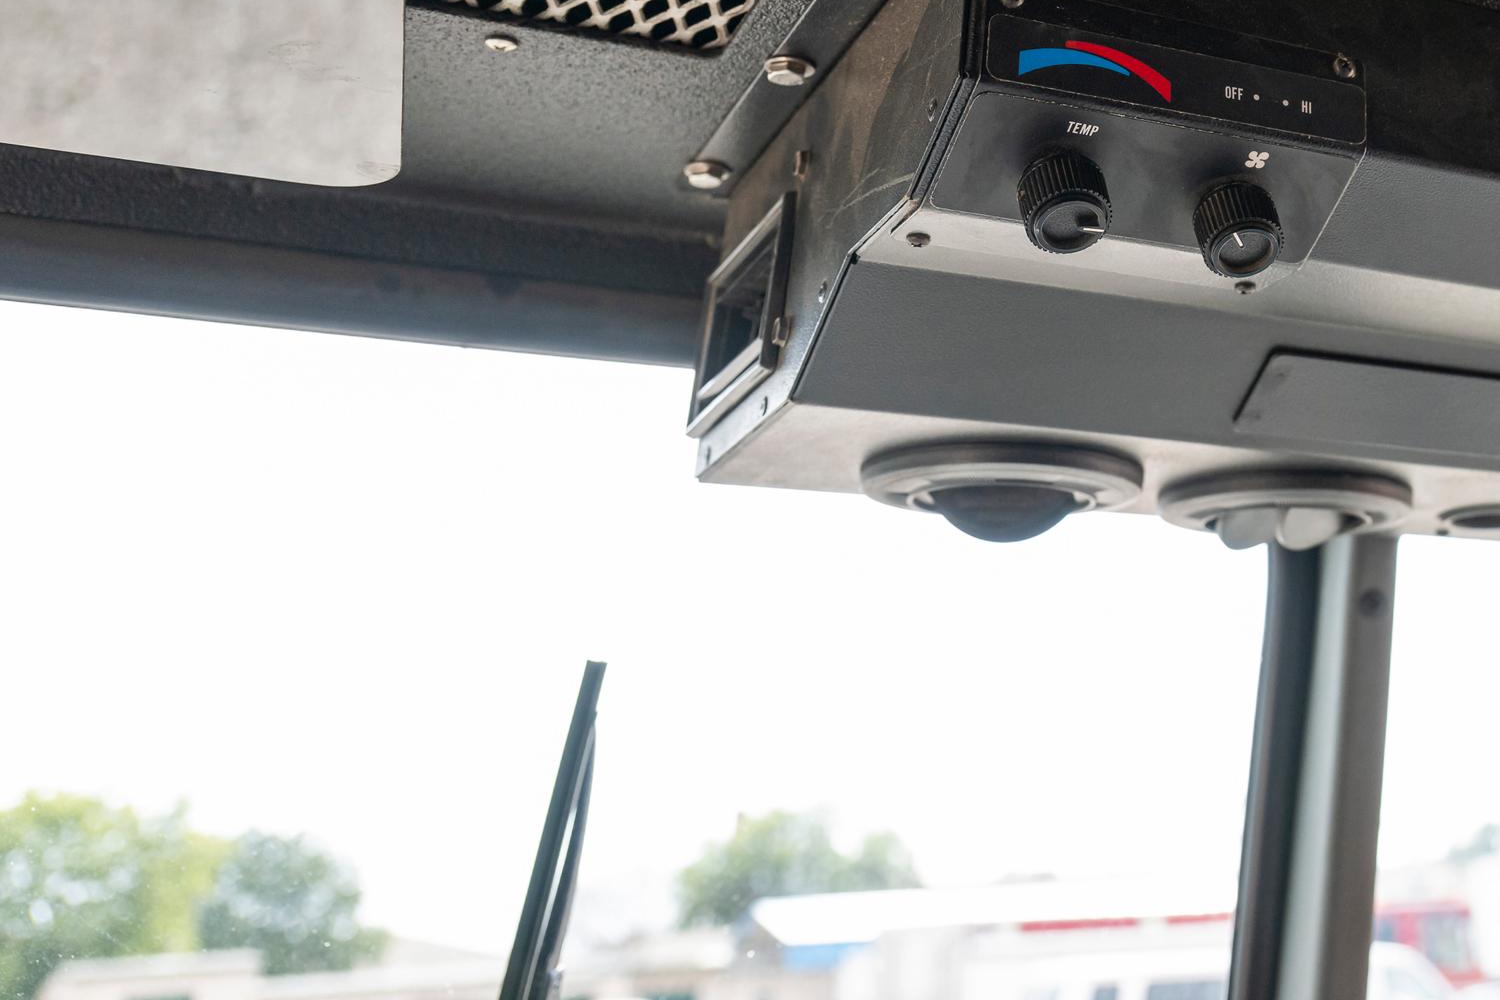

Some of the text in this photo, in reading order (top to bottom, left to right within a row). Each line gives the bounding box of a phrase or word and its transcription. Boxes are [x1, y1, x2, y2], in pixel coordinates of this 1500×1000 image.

[1224, 86, 1312, 114] OFF HI
[1066, 121, 1100, 138] TEMP
